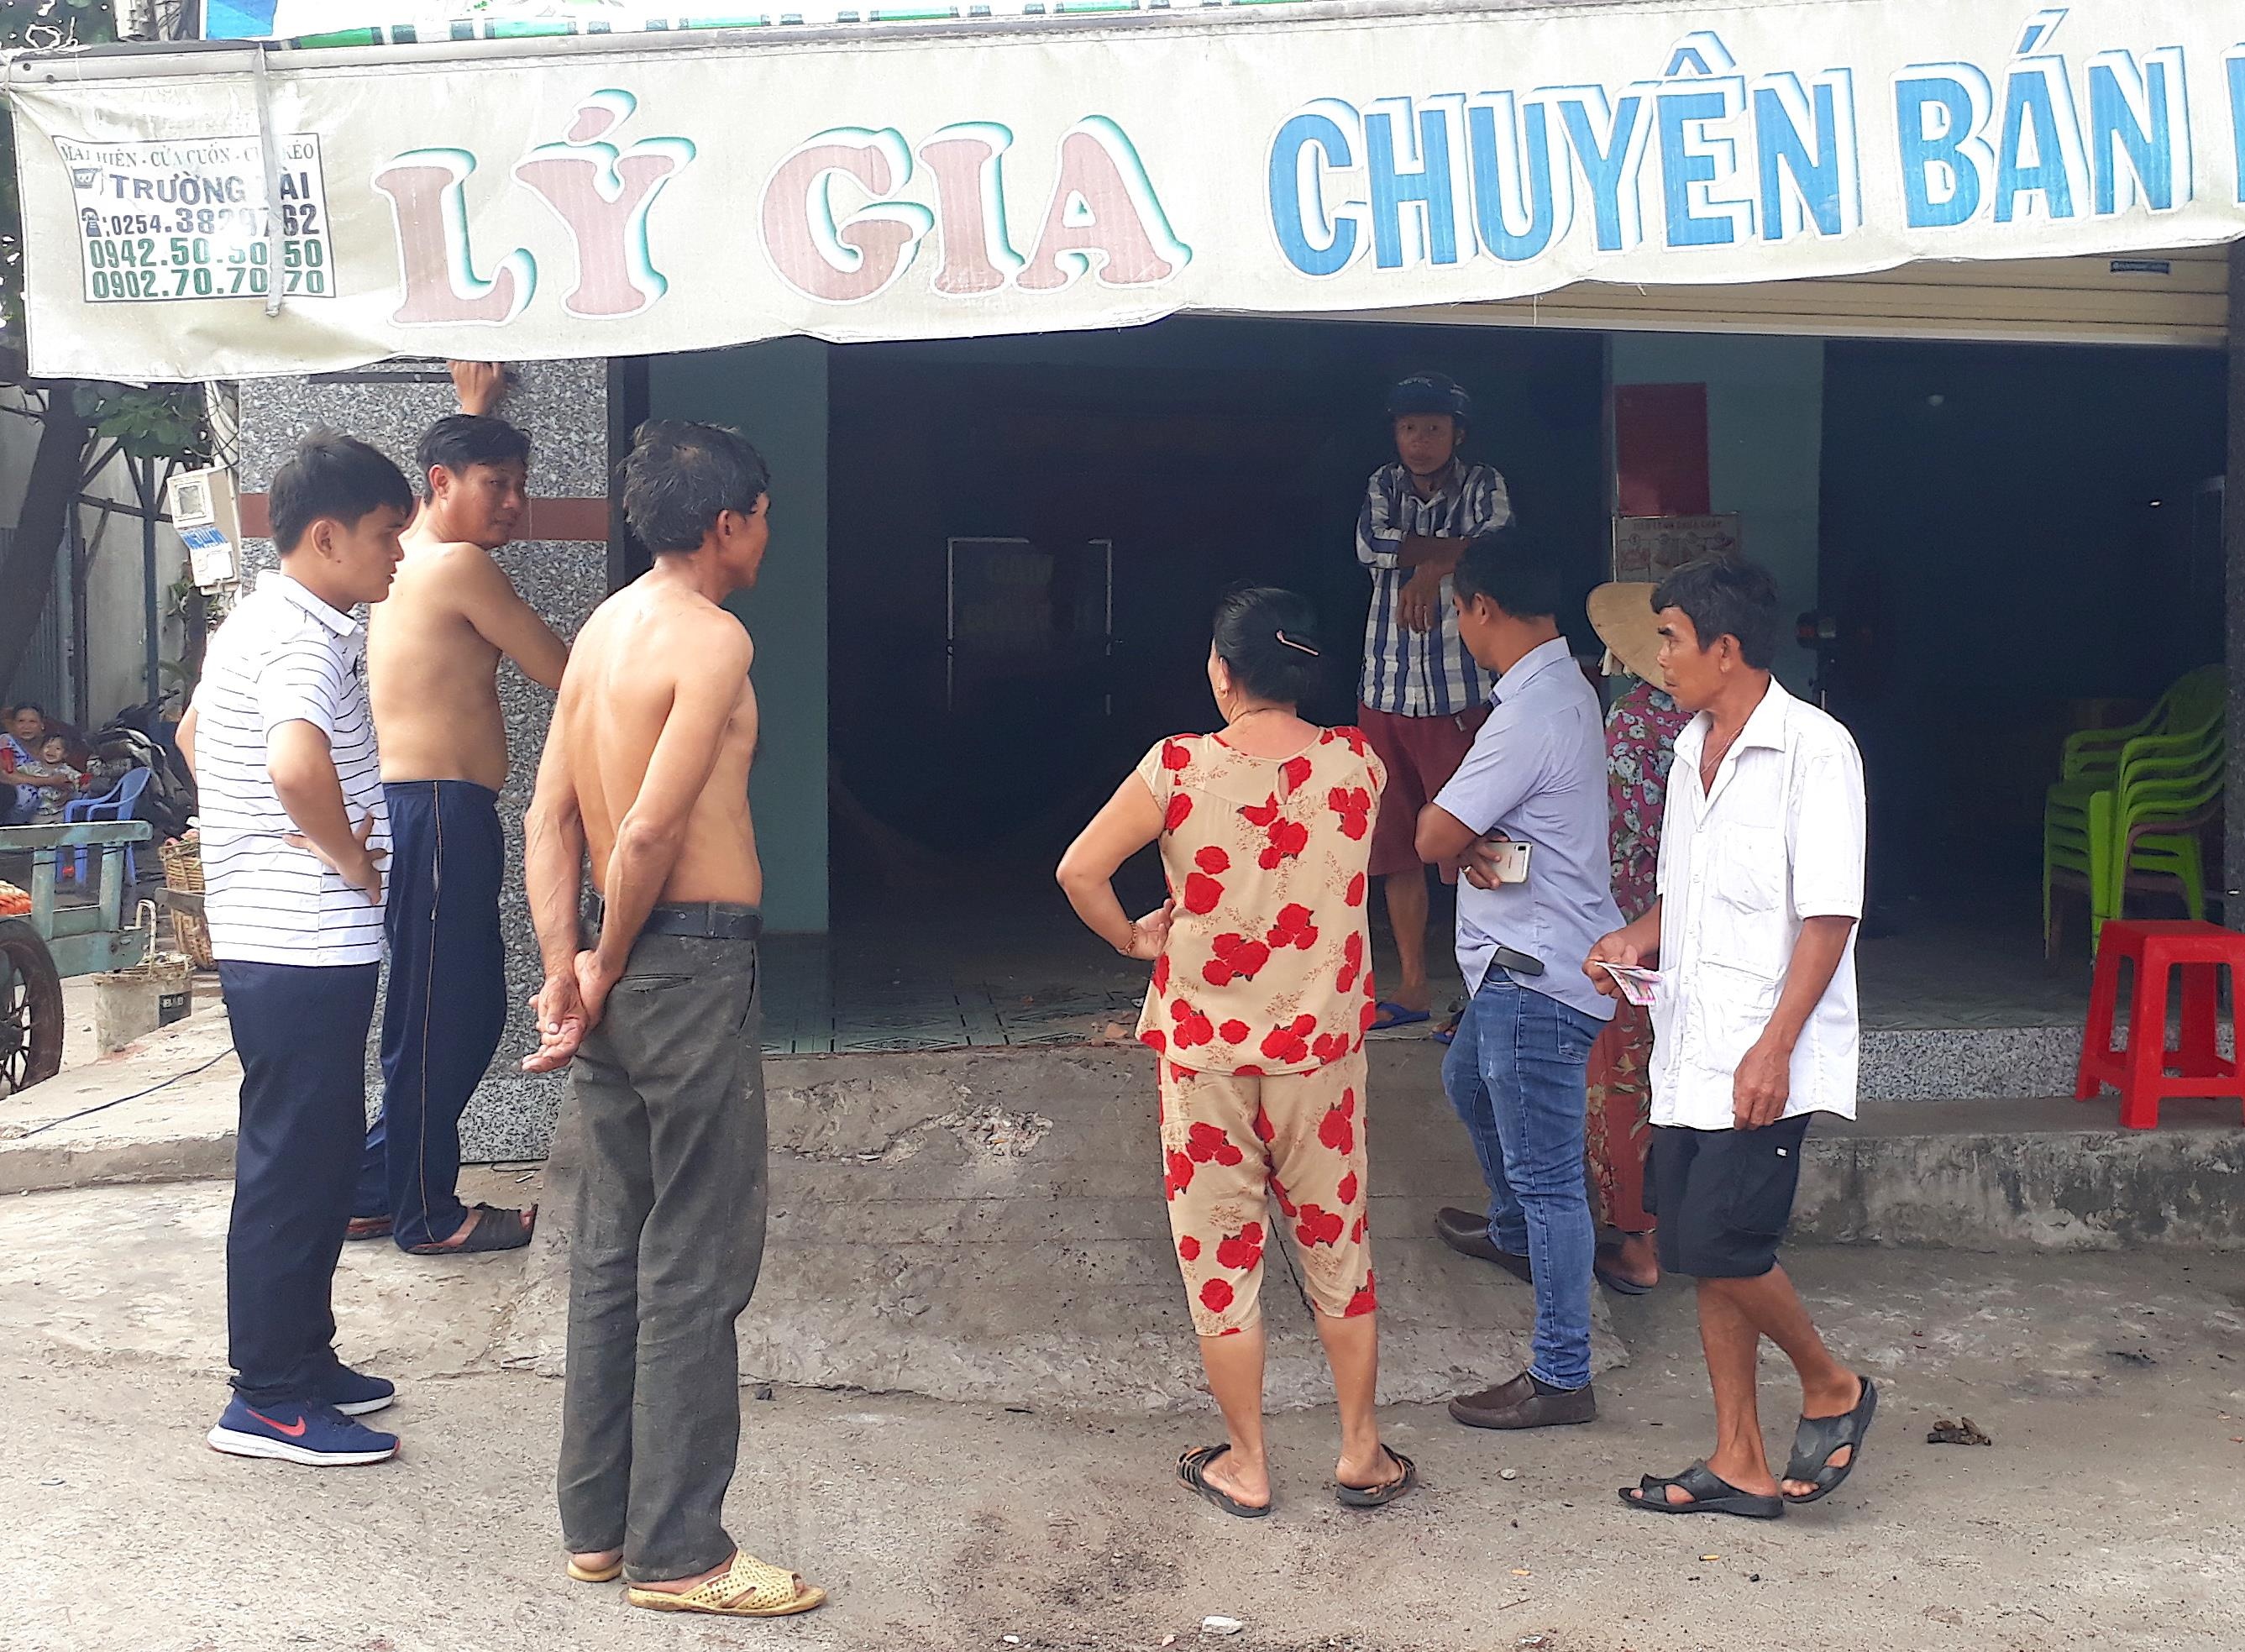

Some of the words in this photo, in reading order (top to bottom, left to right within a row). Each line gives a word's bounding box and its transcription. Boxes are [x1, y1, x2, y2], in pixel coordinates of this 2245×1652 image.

[758, 116, 1192, 303] GIA
[1265, 34, 1859, 278] CHUYÊN
[1891, 10, 2192, 230] BÁN
[109, 170, 245, 205] TRƯỜNG
[89, 238, 323, 269] 0942.50.5050
[92, 267, 324, 298] 0902.70.7070
